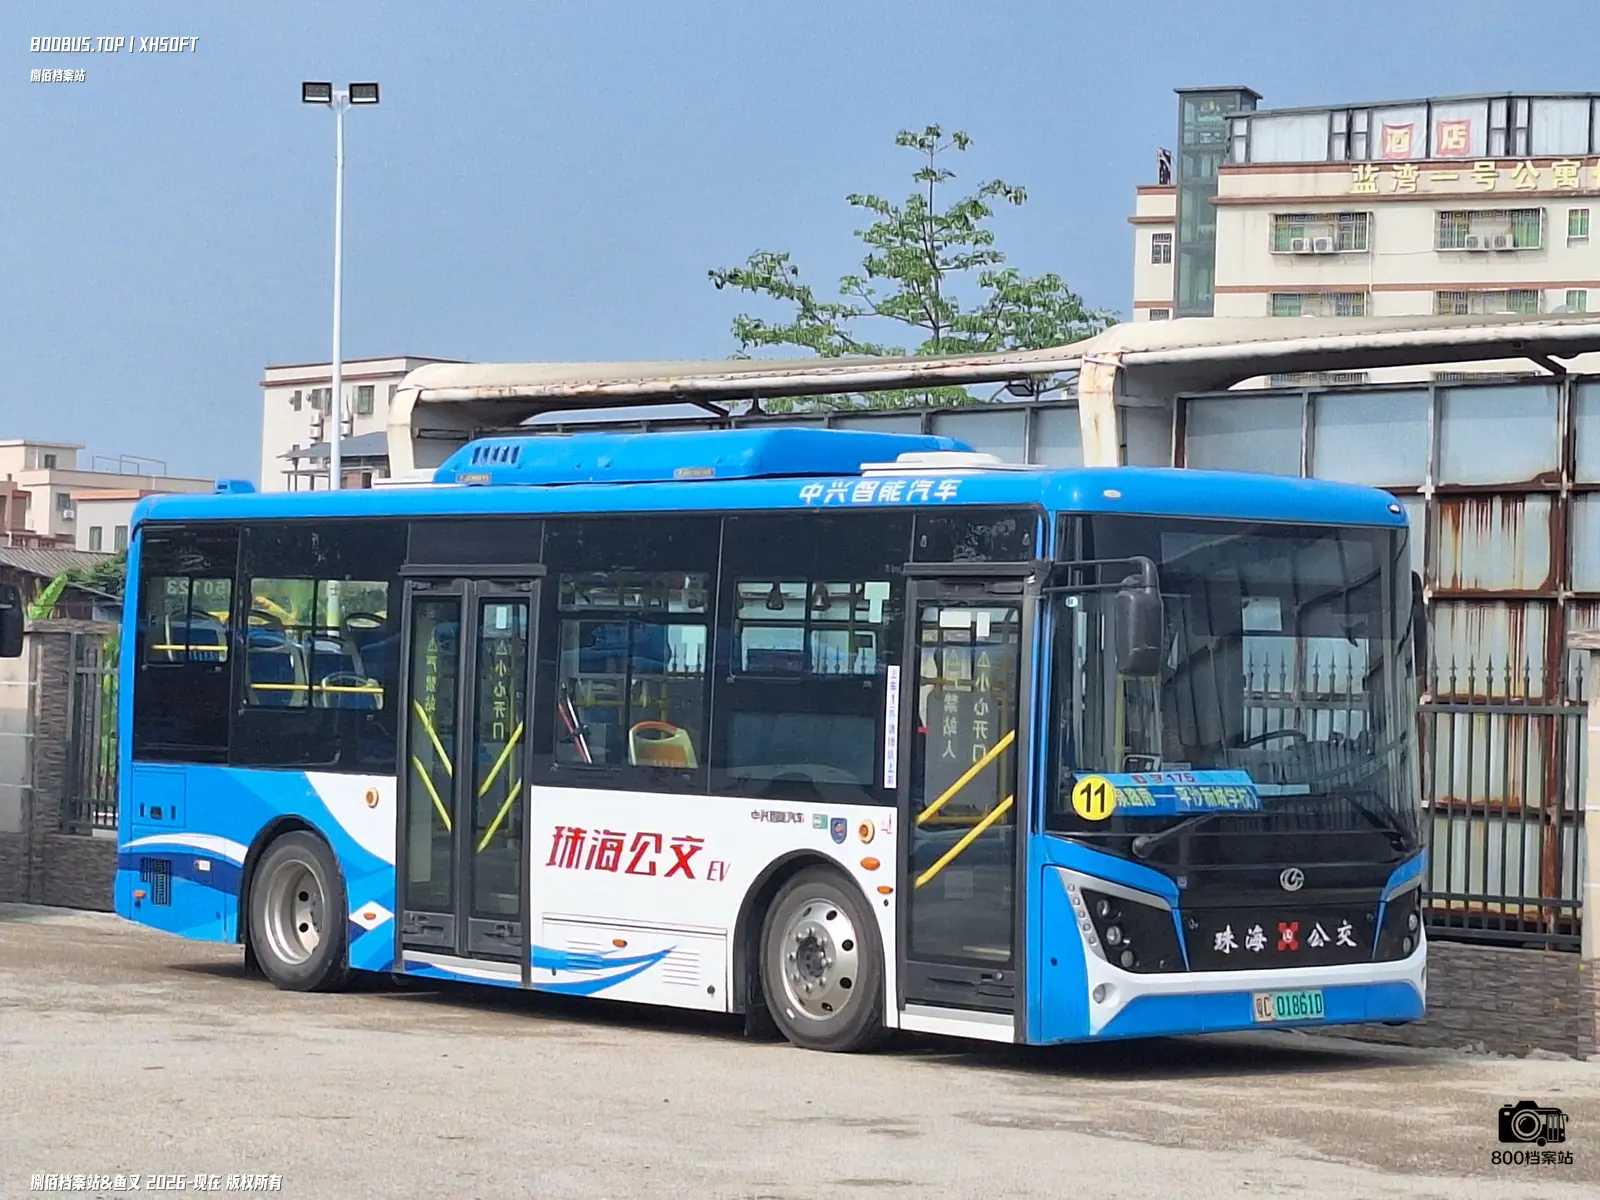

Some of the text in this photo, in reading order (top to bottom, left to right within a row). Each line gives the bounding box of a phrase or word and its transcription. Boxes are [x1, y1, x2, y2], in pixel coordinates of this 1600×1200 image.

[1385, 123, 1470, 156] 酒店
[1350, 159, 1600, 195] 蓝湾一号公寓
[799, 479, 962, 504] 中兴智能汽车
[1080, 783, 1107, 813] 11
[545, 825, 732, 882] 珠海公交 EV
[1214, 919, 1358, 954] 珠海 公交
